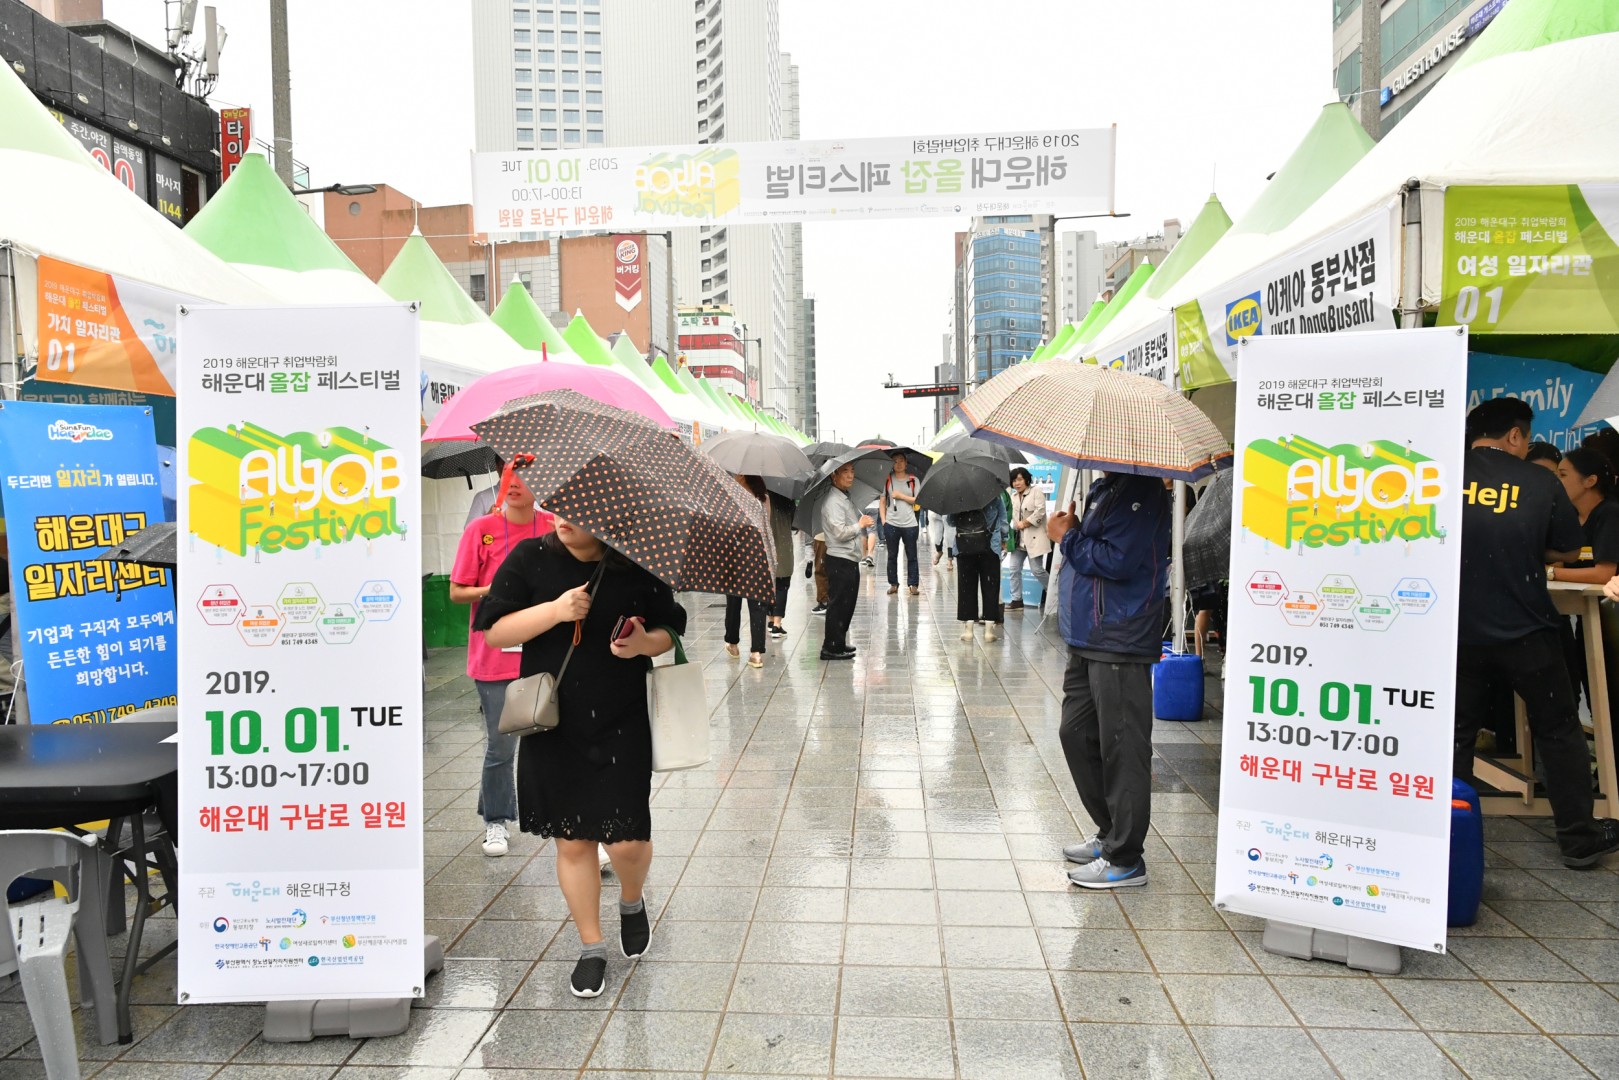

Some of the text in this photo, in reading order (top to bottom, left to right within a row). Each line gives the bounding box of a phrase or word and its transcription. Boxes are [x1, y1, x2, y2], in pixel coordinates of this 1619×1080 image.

[1392, 24, 1466, 95] GUESTHOUSE
[114, 142, 143, 164] 금액동일
[156, 173, 181, 195] 마사지
[159, 199, 181, 219] 1144
[1455, 217, 1567, 228] 2019 해운대구 취업박람회
[1454, 230, 1568, 244] 해운대 올잡 페스티벌
[620, 248, 636, 258] KING
[1457, 254, 1593, 276] 여성 일자리관
[616, 264, 640, 274] 버거킹
[1267, 238, 1376, 317] 이케아 동부산점
[44, 280, 58, 290] 2019
[44, 292, 66, 306] 해운대
[82, 300, 107, 316] 페스티벌
[1454, 286, 1504, 324] 01
[48, 313, 121, 344] 가치 일자리관
[1229, 304, 1260, 332] IKEA
[47, 338, 76, 372] 01
[203, 355, 338, 369] 2019 해운대구 취업박람회
[202, 370, 401, 394] 해운대 올잡 페스티벌
[1259, 377, 1383, 390] 2019 해운대구 취업박람회
[19, 392, 85, 404] 운대구와
[1258, 389, 1444, 410] 해운대 올잡 페스티벌
[7, 468, 158, 489] 두드리면 일자리가 열립니다.
[1462, 482, 1520, 514] Hej!
[34, 511, 148, 552] 해운대구
[240, 497, 404, 557] Festival
[1286, 504, 1445, 550] Festival
[23, 562, 167, 602] 일자리센터
[28, 610, 174, 645] 기업과 구직자 모두에게
[47, 635, 167, 670] 든든한 힘이 되기를
[1250, 644, 1312, 667] 2019.
[76, 662, 149, 688] 희망합니다.
[206, 670, 276, 694] 2019.
[1383, 688, 1435, 709] TUE
[351, 706, 403, 727] TUE
[1247, 721, 1399, 757] 13:00~17:00
[205, 762, 369, 789] 13:00~17:00
[1240, 754, 1434, 800] 해운대 구남로 일원
[200, 802, 406, 832] 해운대 구남로 일원
[1315, 831, 1377, 852] 해운대구청
[198, 880, 351, 902] 주관 해운대 해운대구청
